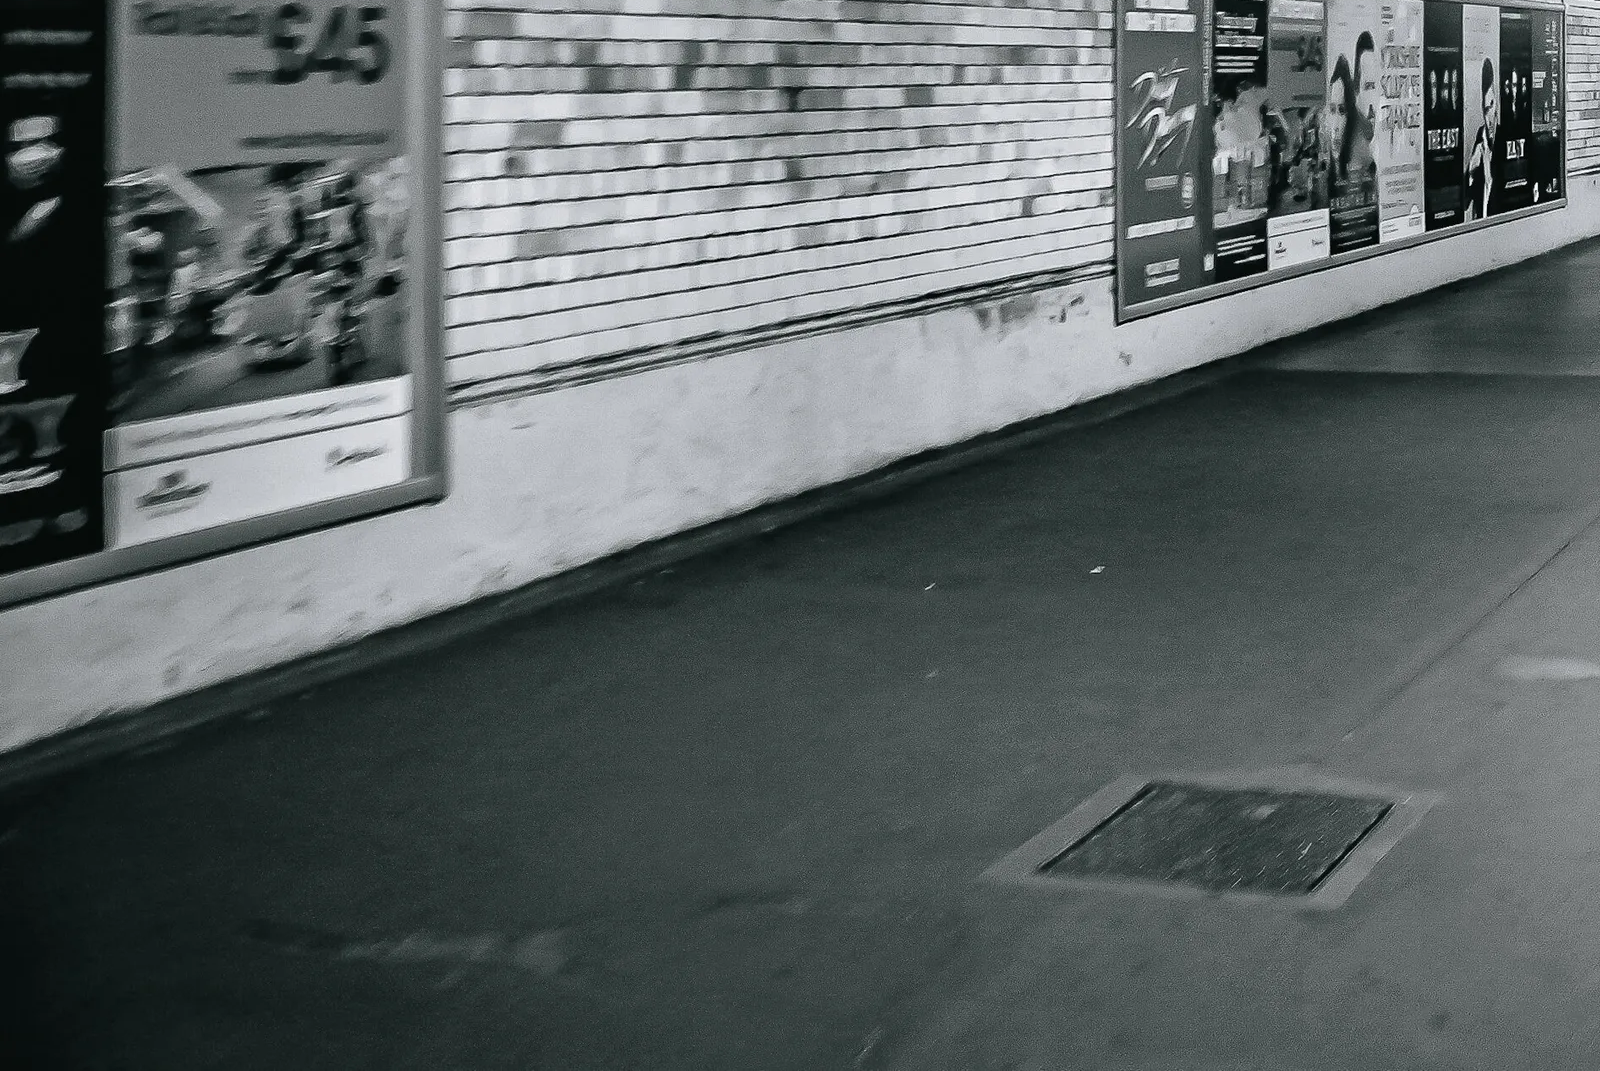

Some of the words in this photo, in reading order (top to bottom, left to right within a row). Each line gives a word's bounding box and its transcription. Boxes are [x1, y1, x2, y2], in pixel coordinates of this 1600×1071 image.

[265, 2, 392, 84] £45
[1427, 129, 1441, 150] THE
[1442, 127, 1459, 149] EAST
